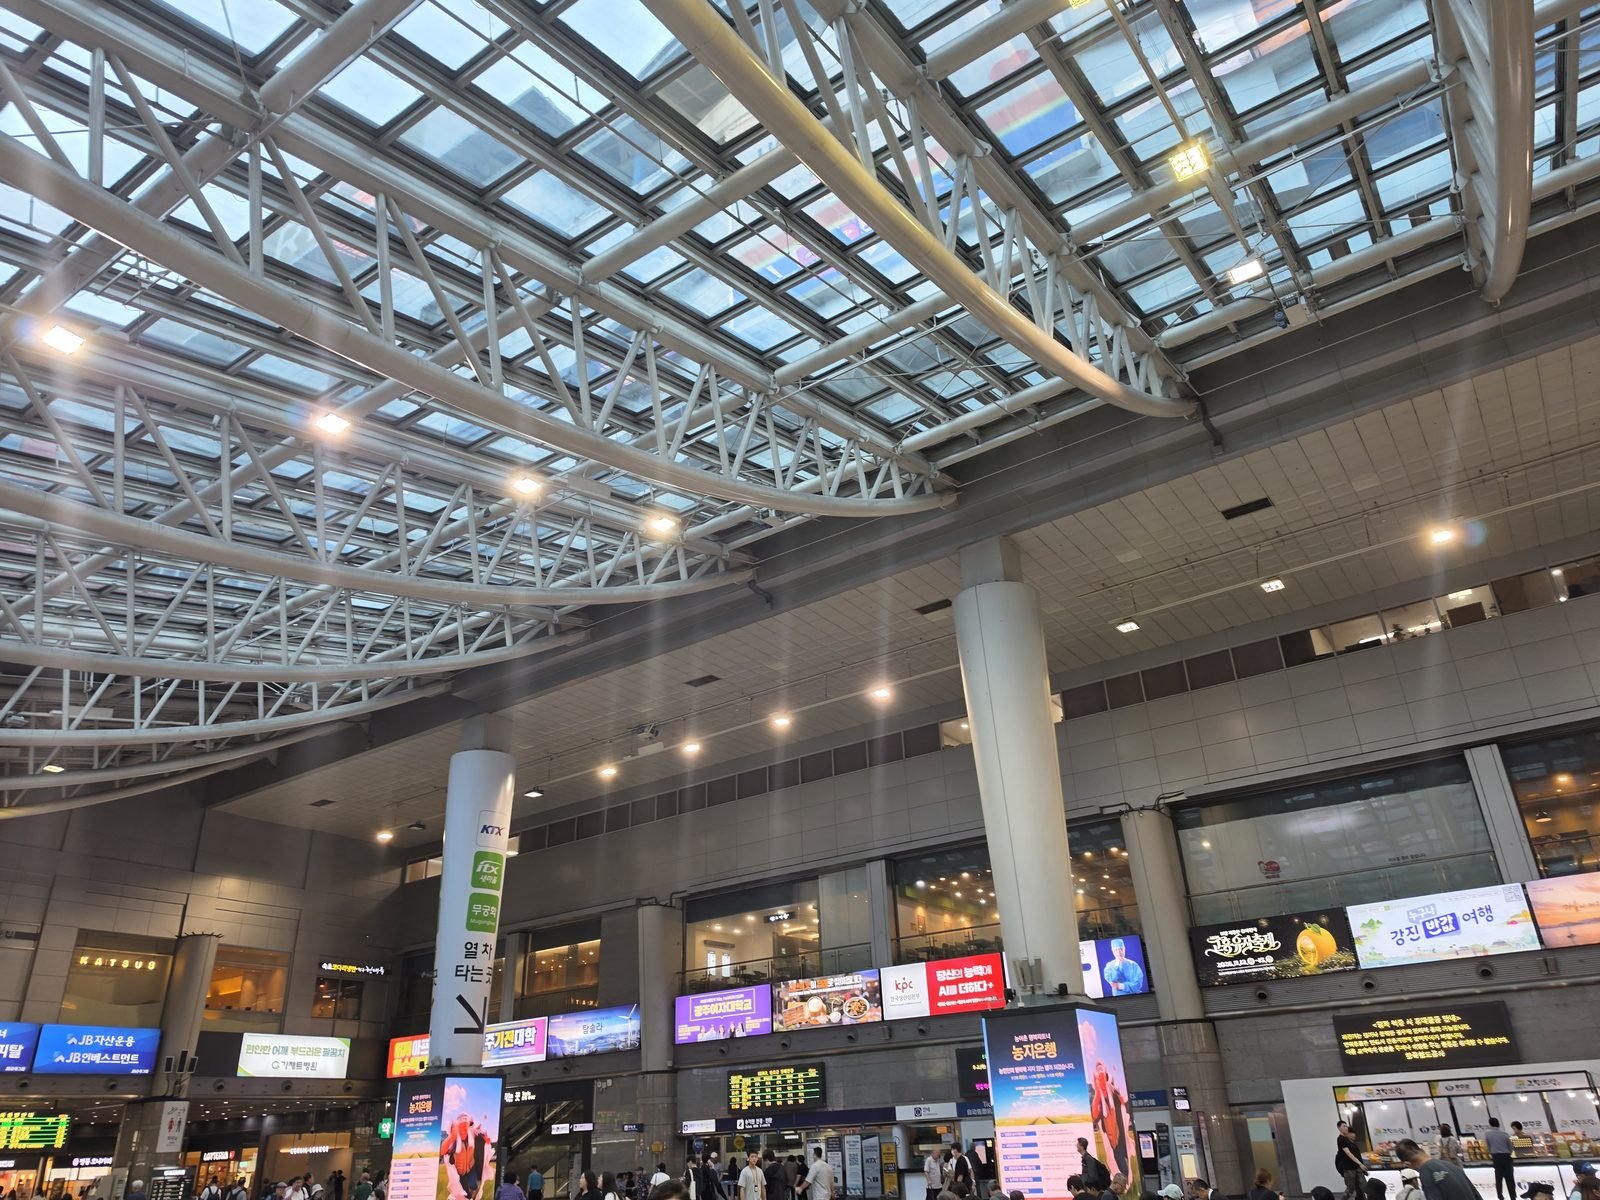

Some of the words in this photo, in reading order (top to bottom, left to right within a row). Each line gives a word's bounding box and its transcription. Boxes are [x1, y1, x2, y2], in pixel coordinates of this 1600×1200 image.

[480, 824, 505, 836] KTX
[480, 876, 498, 884] 새마을
[472, 904, 496, 918] 무궁화
[1408, 904, 1436, 919] 누구나
[1390, 925, 1421, 946] 강진
[1426, 915, 1455, 936] 반값
[1462, 904, 1494, 924] 여행
[936, 968, 963, 981] 당신의
[964, 965, 992, 978] 능력에
[895, 977, 913, 993] kpc
[938, 985, 957, 996] AI를
[694, 999, 752, 1017] 광주여자대학교
[582, 1023, 603, 1034] 탑솔라
[78, 1034, 135, 1047] JB자산운용
[246, 1044, 271, 1055] 편안한
[272, 1045, 289, 1056] 어깨
[290, 1046, 321, 1057] 부드러운
[322, 1047, 345, 1058] 팔꿈치
[1012, 1041, 1057, 1061] 농지은행
[66, 1052, 139, 1065] JB인베스트먼트
[409, 1100, 432, 1114] 농지은행
[381, 1122, 391, 1135] 약
